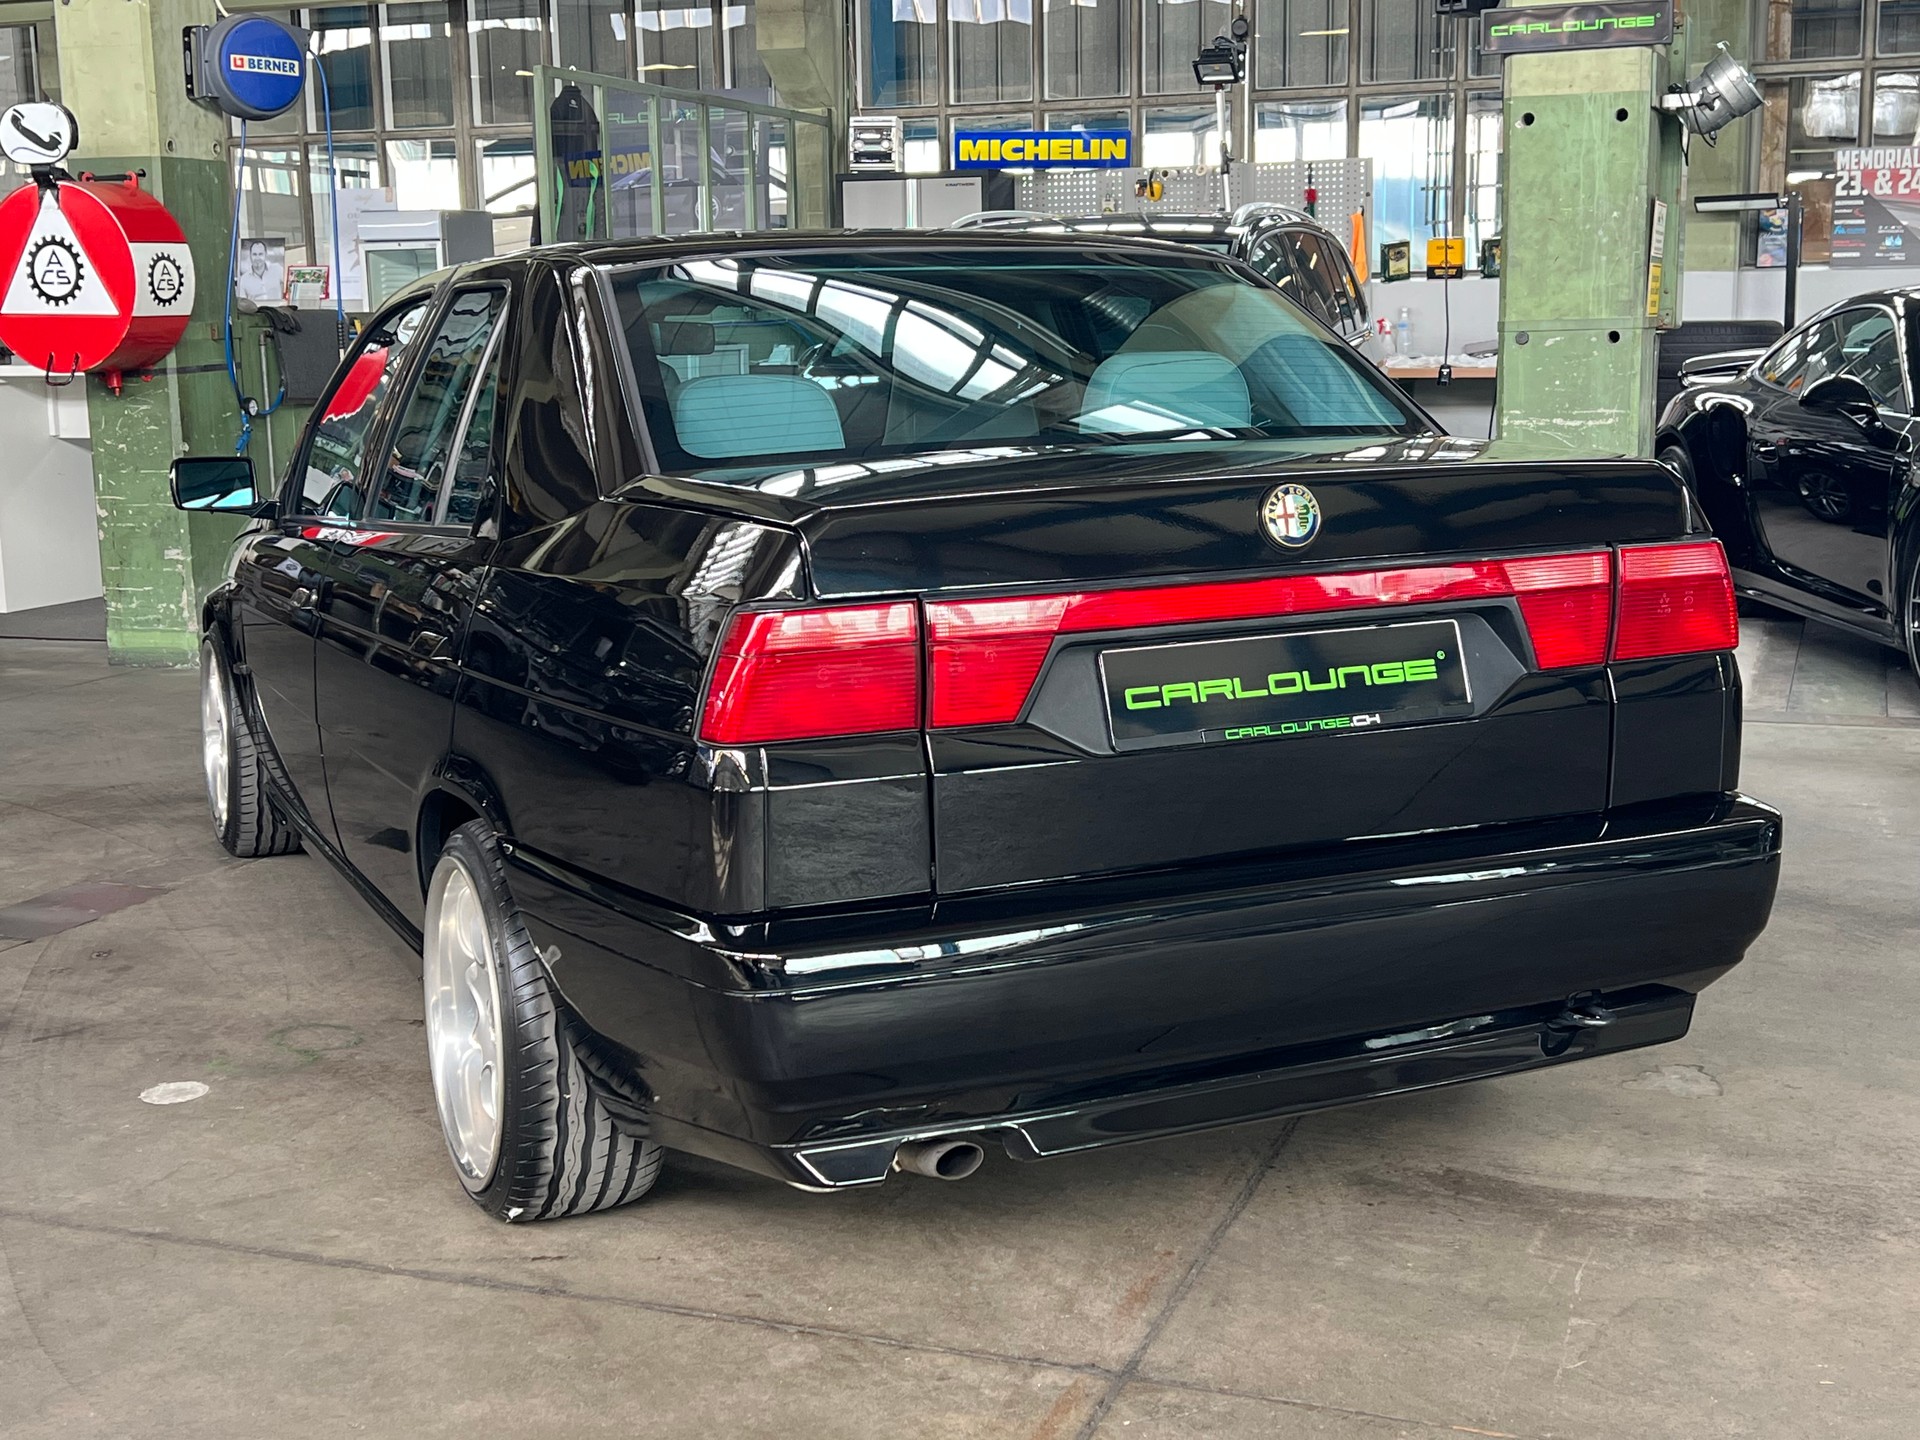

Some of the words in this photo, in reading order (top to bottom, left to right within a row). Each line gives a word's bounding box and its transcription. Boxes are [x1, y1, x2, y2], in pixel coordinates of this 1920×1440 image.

[1490, 15, 1655, 37] CARLOUNGE
[247, 57, 296, 74] BERNER
[959, 138, 1126, 161] MICHELIN
[1837, 148, 1920, 171] MEMORIAL
[1835, 169, 1869, 196] 23.
[1873, 168, 1893, 195] &
[1897, 167, 1920, 195] 24
[1266, 490, 1286, 519] ALFA
[1124, 657, 1438, 710] CARLOUNGE
[1224, 713, 1381, 741] CARLOUNGE.CH
